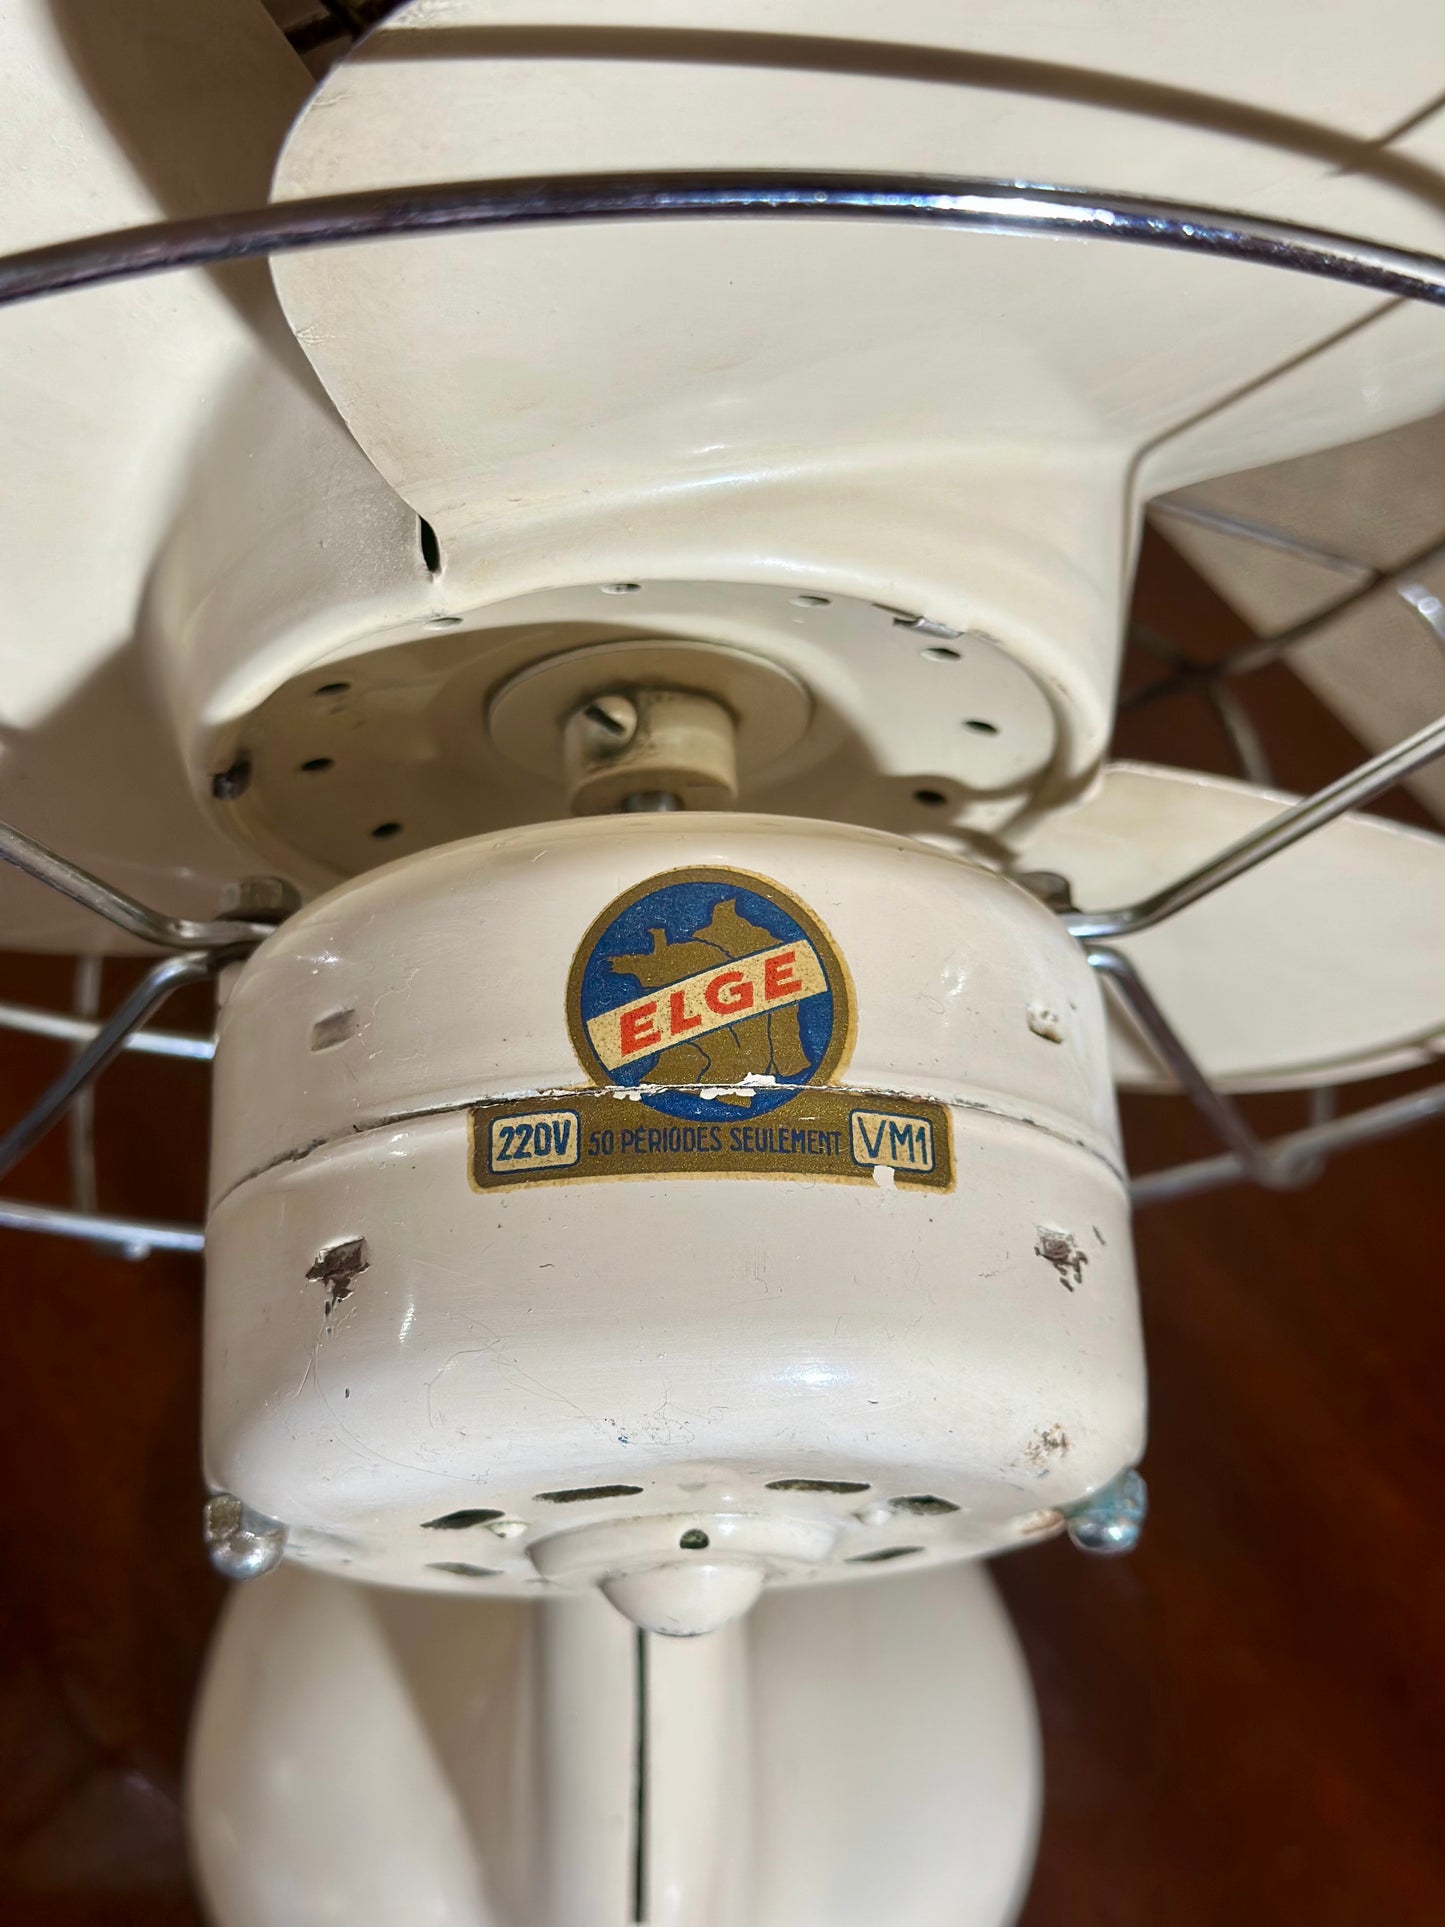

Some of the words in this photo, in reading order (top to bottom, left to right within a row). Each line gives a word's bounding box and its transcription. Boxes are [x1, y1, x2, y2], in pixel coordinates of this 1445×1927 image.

[619, 950, 802, 1058] ELGE
[496, 1119, 572, 1162] 220V
[588, 1129, 615, 1156] 50
[621, 1125, 722, 1153] PÉRIODES
[729, 1126, 841, 1157] SEULEMENT
[857, 1116, 928, 1165] VM1
